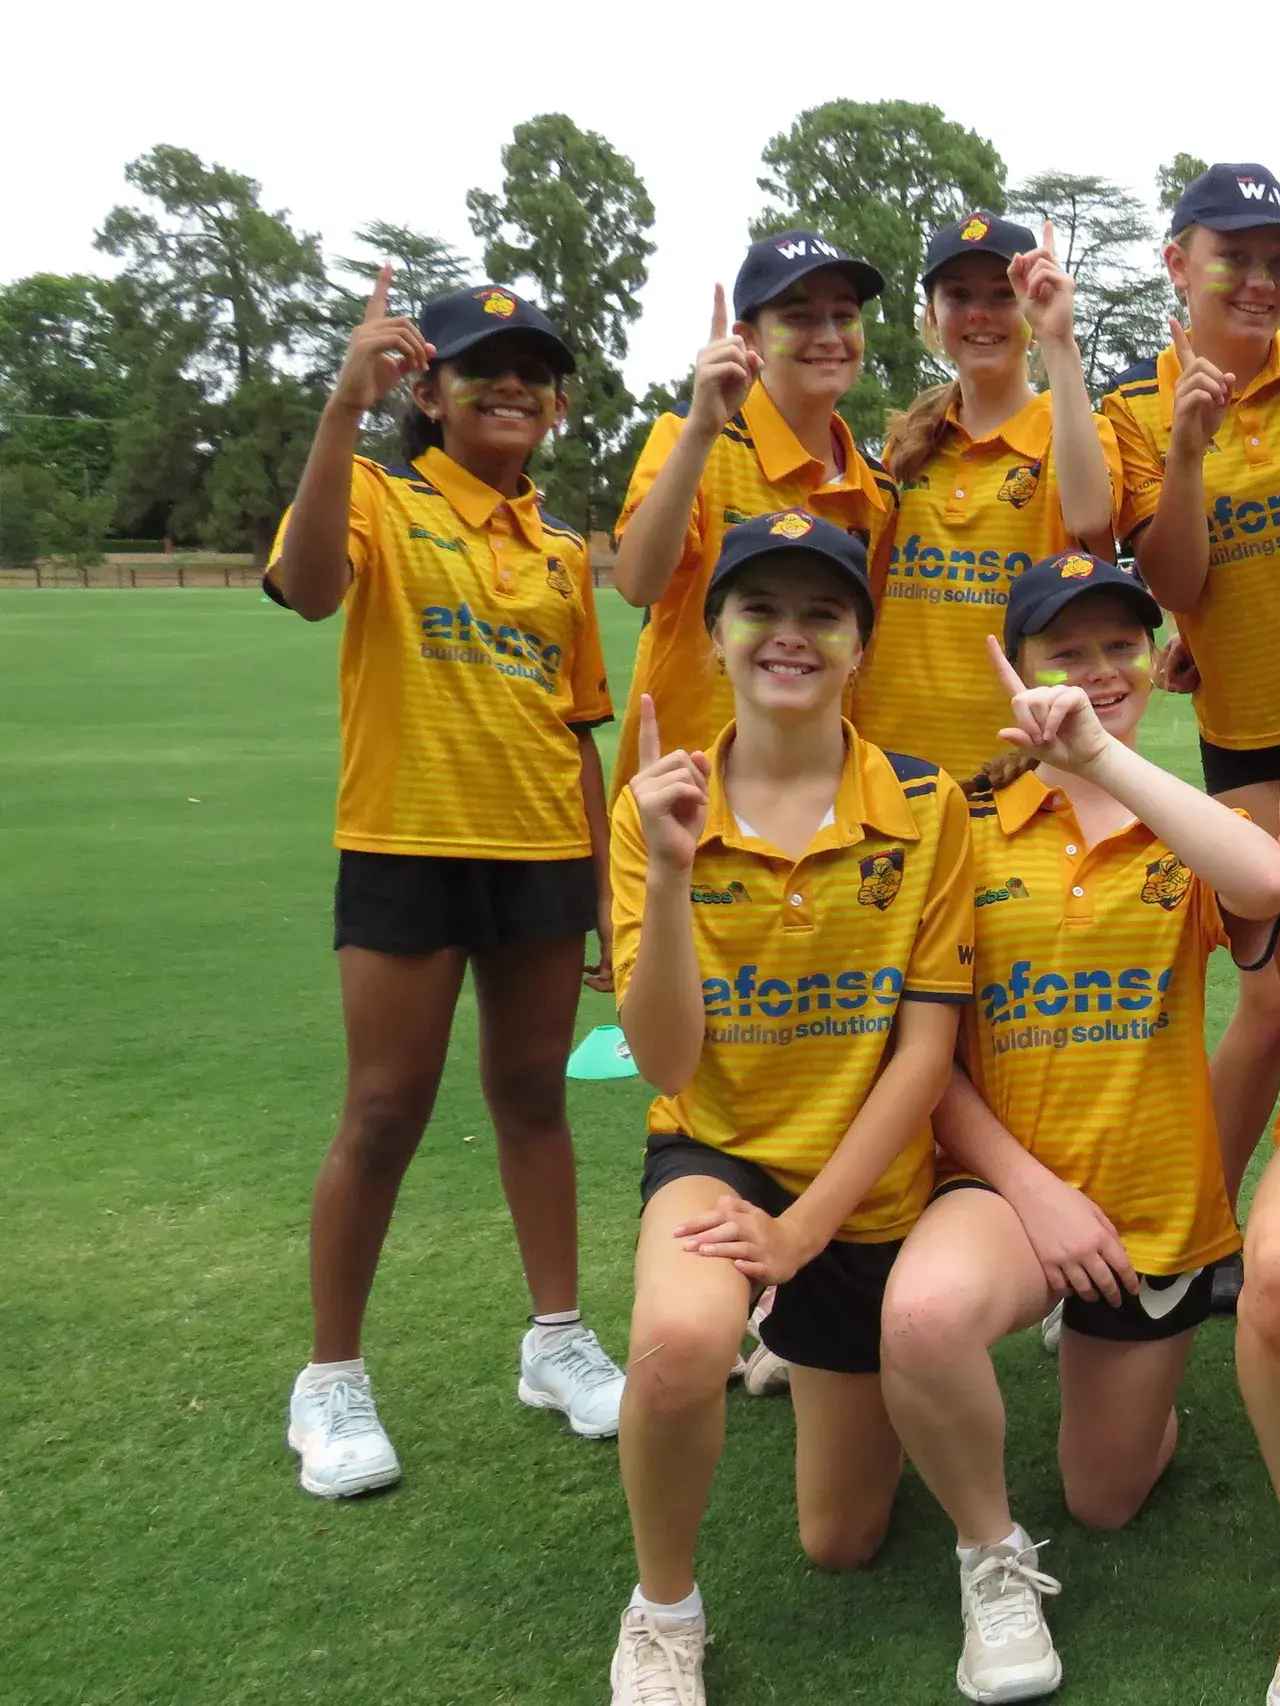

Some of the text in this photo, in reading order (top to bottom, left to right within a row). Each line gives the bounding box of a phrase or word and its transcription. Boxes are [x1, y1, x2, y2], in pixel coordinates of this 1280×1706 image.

[1209, 539, 1275, 566] uilding
[885, 583, 941, 604] uilding
[702, 964, 904, 1018] afonso
[704, 1023, 794, 1046] uilding
